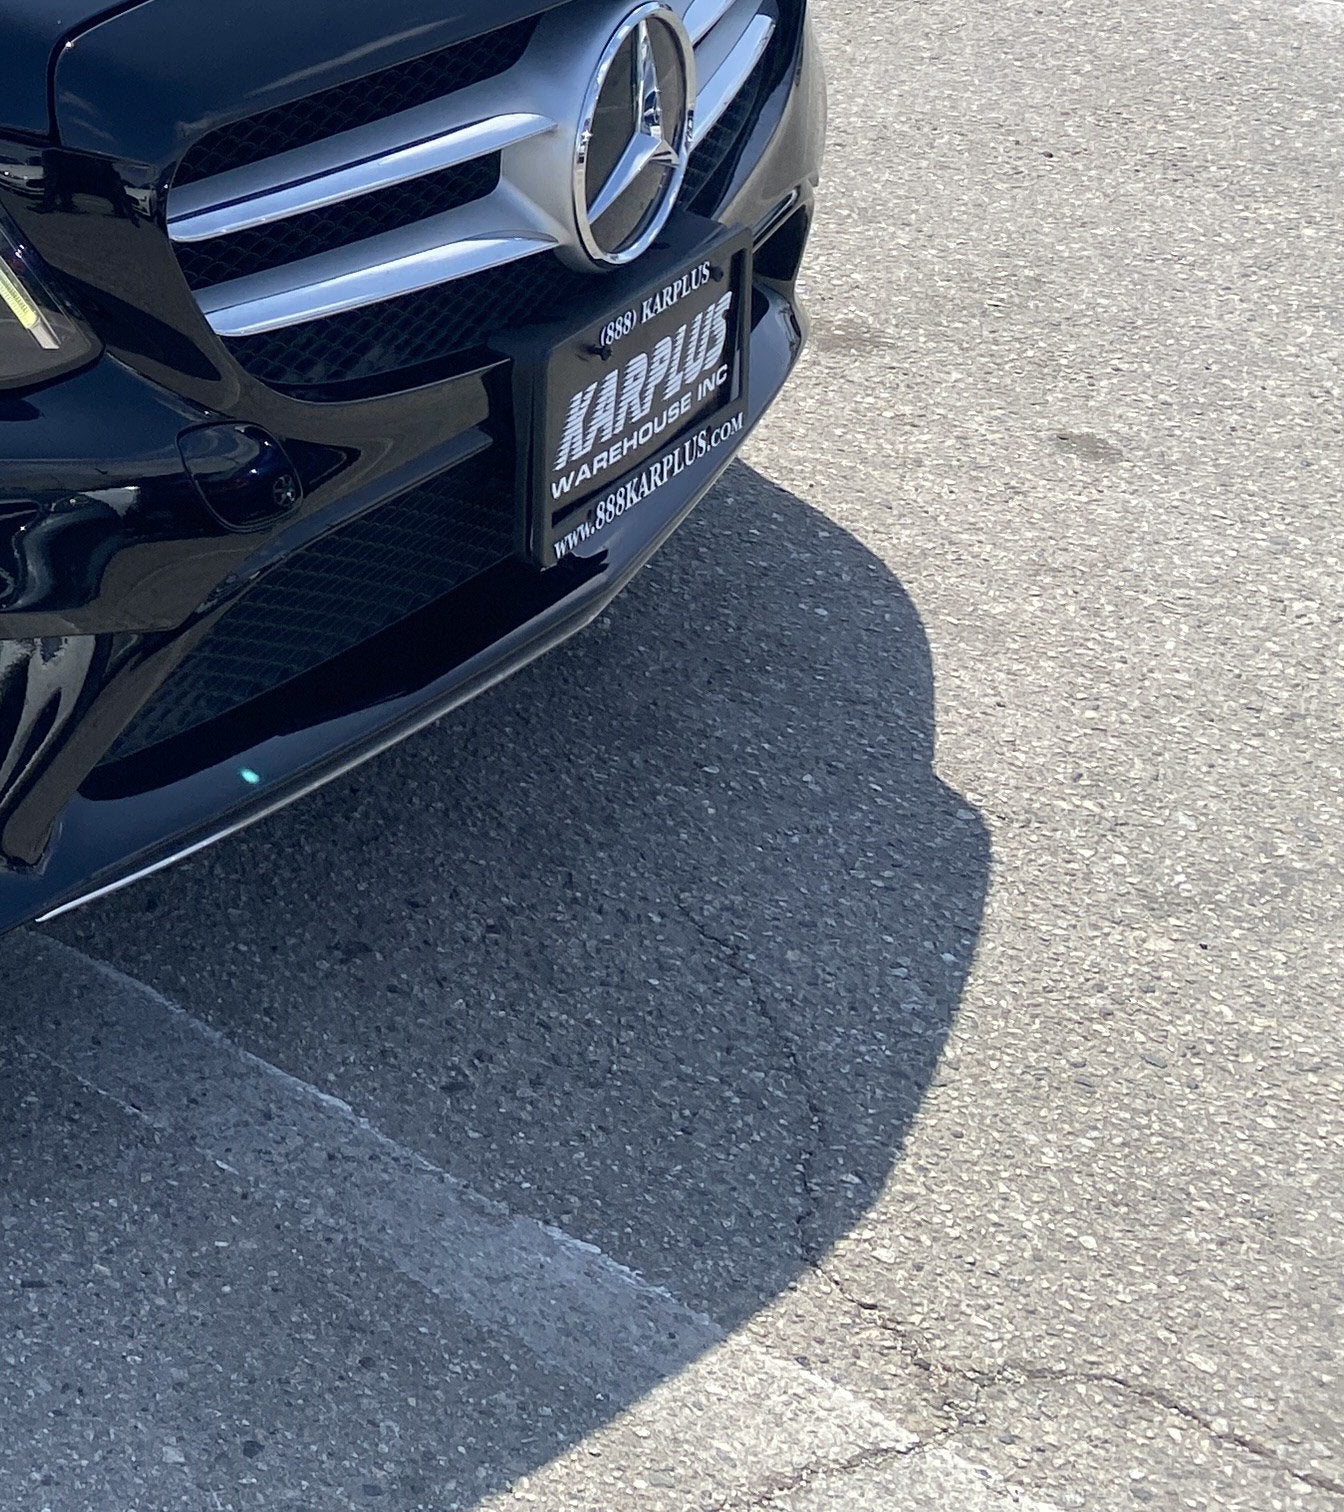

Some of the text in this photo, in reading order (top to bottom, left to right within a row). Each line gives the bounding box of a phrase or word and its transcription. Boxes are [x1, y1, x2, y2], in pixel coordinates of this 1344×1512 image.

[599, 260, 711, 348] (888) KARPLUS
[551, 363, 728, 500] WAREHOUSE INC
[552, 290, 734, 472] KARPLUS
